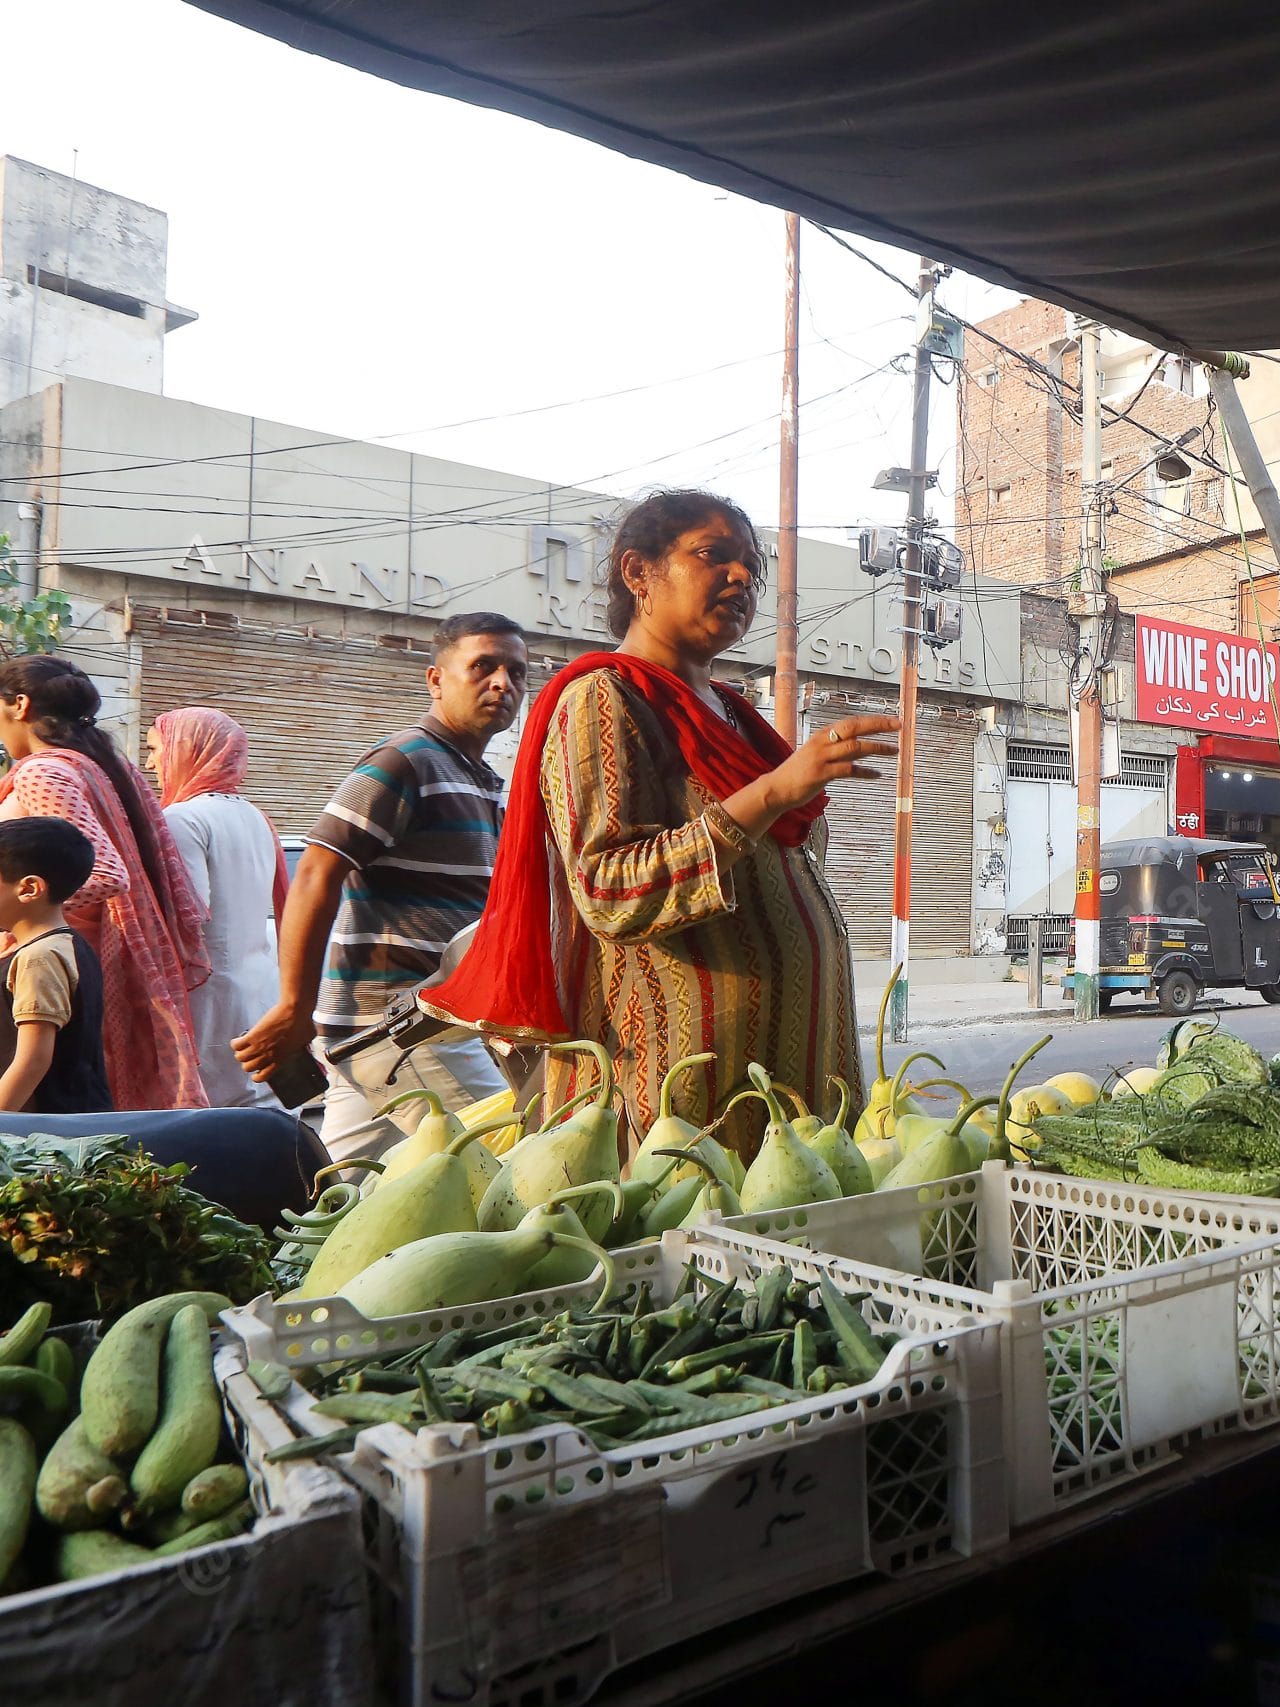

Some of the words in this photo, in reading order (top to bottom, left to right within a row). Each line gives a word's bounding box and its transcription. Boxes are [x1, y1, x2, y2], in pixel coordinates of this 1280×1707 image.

[172, 534, 450, 608] ANAND
[809, 637, 977, 686] STOES
[1141, 626, 1208, 693] WINE
[1216, 641, 1276, 703] SHOP
